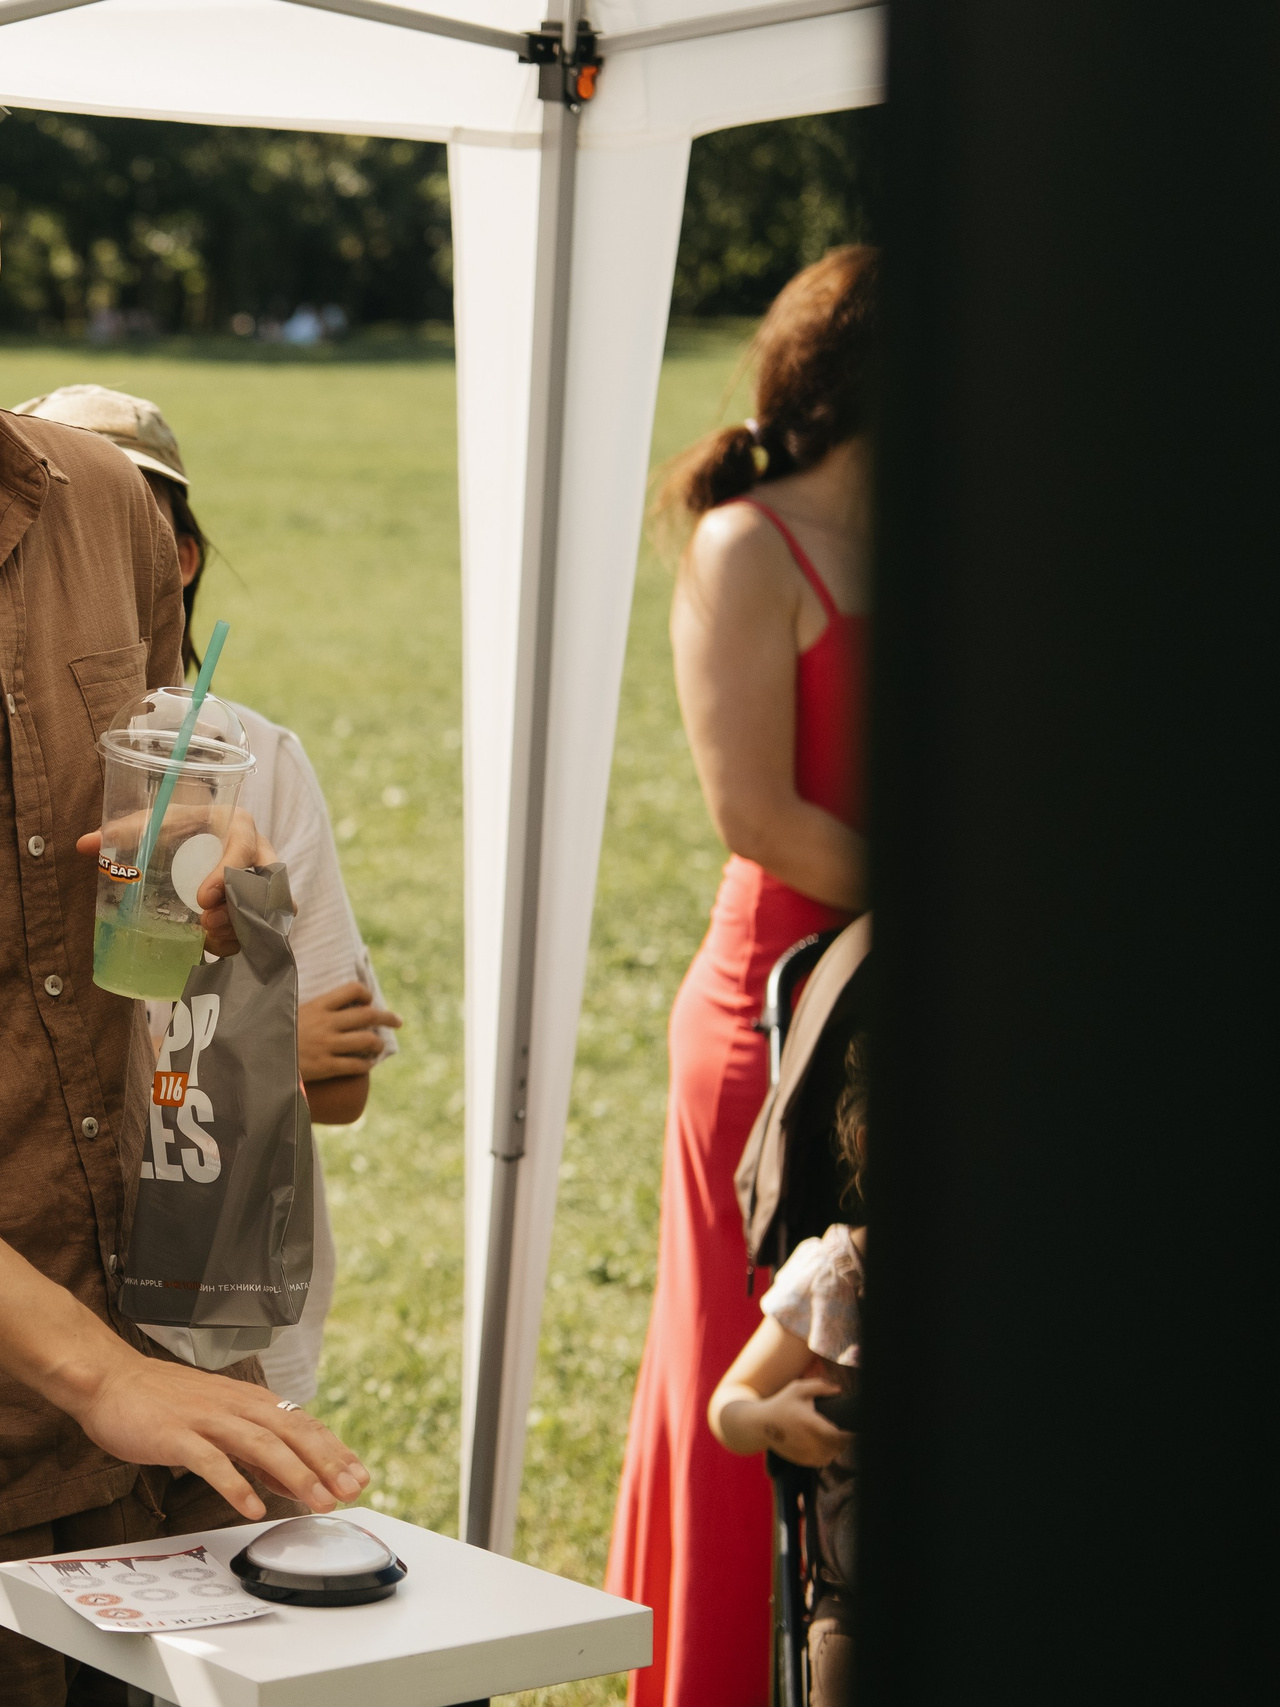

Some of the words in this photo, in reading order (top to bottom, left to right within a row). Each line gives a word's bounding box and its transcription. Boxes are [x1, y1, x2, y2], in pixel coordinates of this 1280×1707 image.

[111, 865, 137, 877] БАР
[160, 1076, 183, 1102] 116
[140, 1280, 162, 1288] APPLE
[218, 1284, 261, 1292] ТЕХНИКИ
[289, 1281, 311, 1291] МАГА
